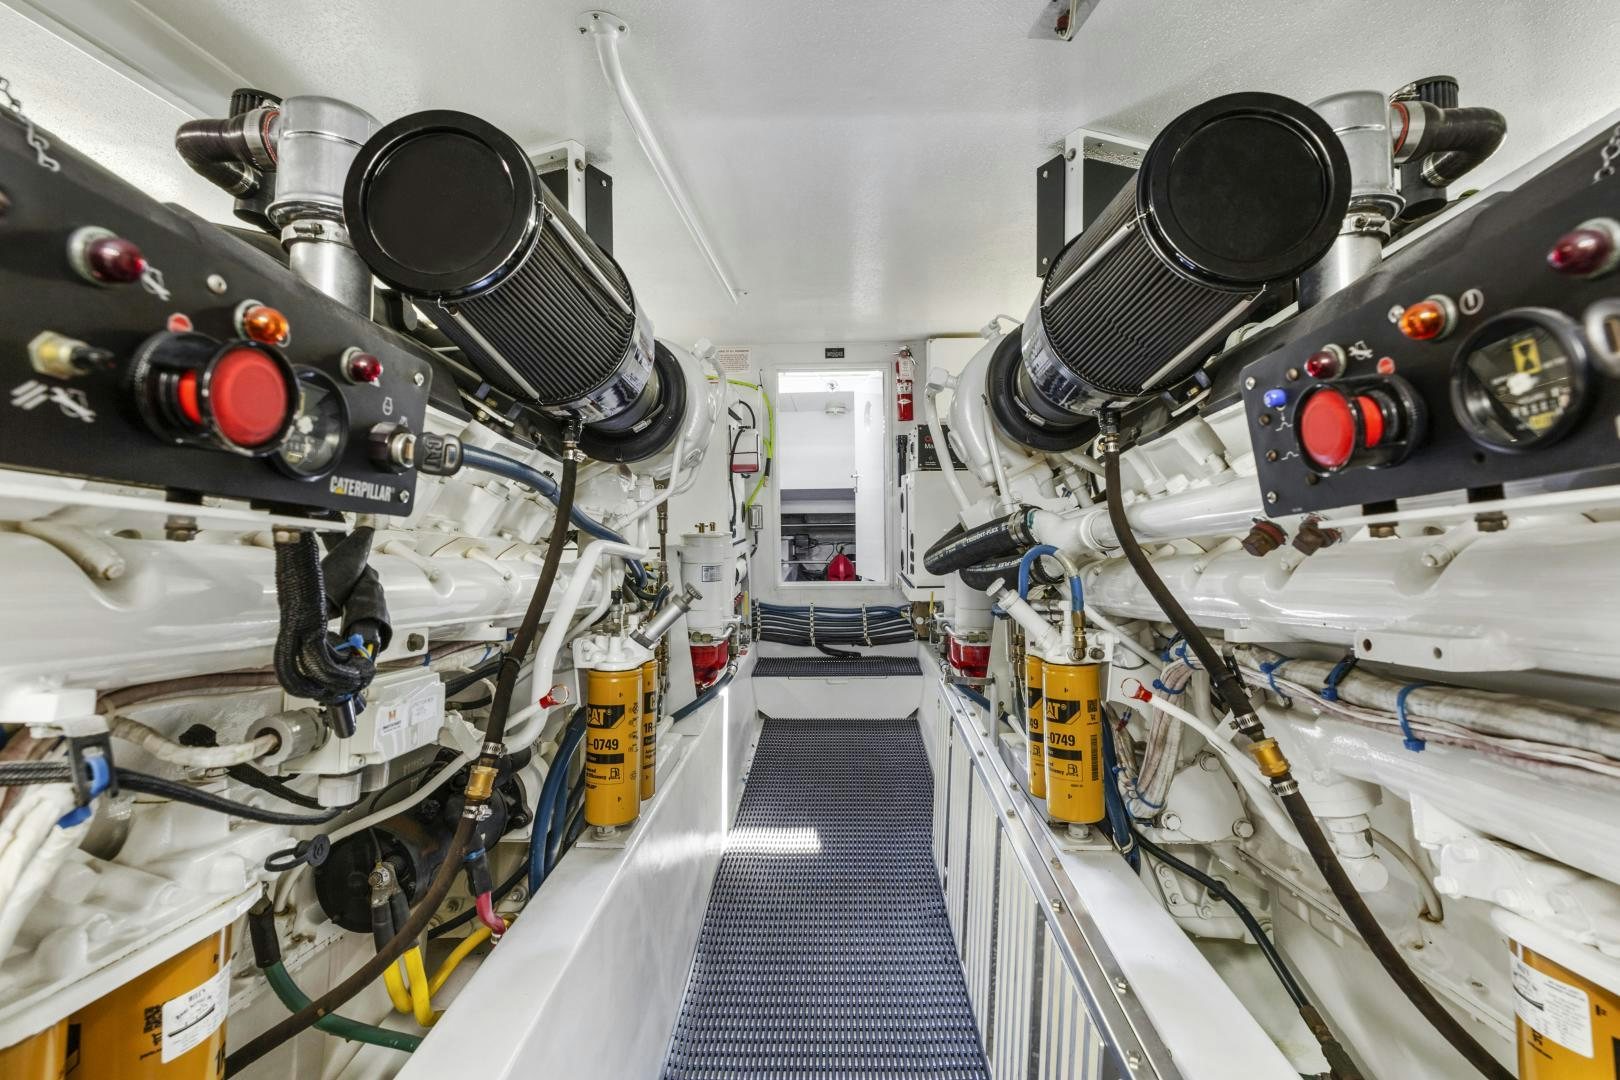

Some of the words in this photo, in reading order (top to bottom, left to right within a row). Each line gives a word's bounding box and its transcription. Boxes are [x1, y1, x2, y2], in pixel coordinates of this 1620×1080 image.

[329, 475, 392, 502] CATERPILLAR
[1047, 701, 1061, 720] AT
[587, 738, 619, 751] -0749
